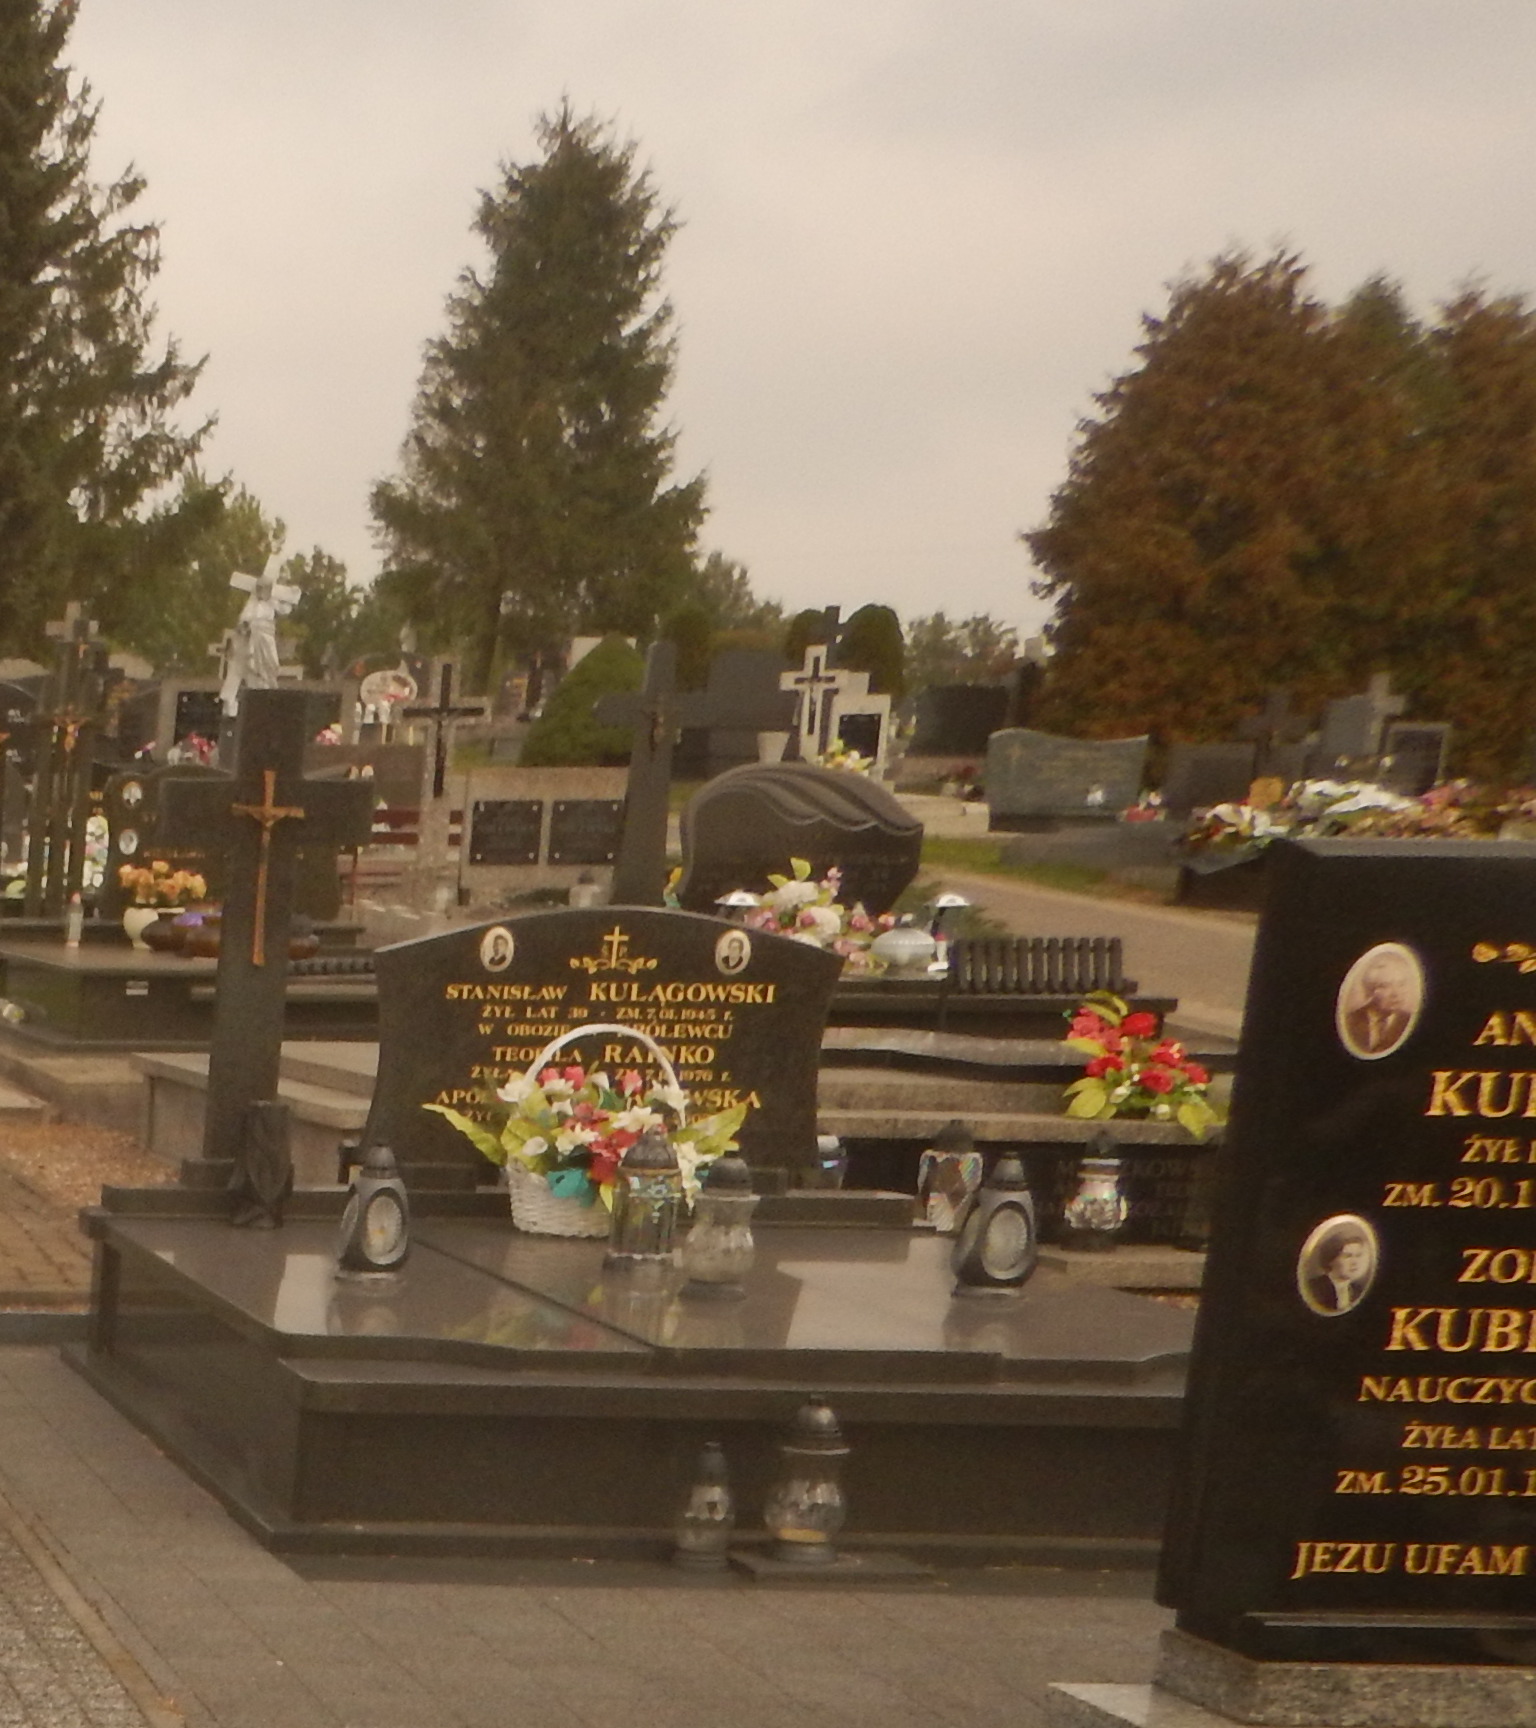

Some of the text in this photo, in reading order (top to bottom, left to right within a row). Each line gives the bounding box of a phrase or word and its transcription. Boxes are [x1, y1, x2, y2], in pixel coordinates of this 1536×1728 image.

[445, 982, 777, 1008] STANISŁAW KULĄGOWSKI
[525, 1005, 559, 1019] LAT
[478, 1023, 495, 1036] W
[616, 1020, 734, 1040] RÓLEWCU
[1381, 1181, 1443, 1208] ZM.
[1401, 1419, 1480, 1450] ŻYŁA
[1334, 1468, 1393, 1495] ZM.
[1289, 1541, 1530, 1580] JEZU UFAM
